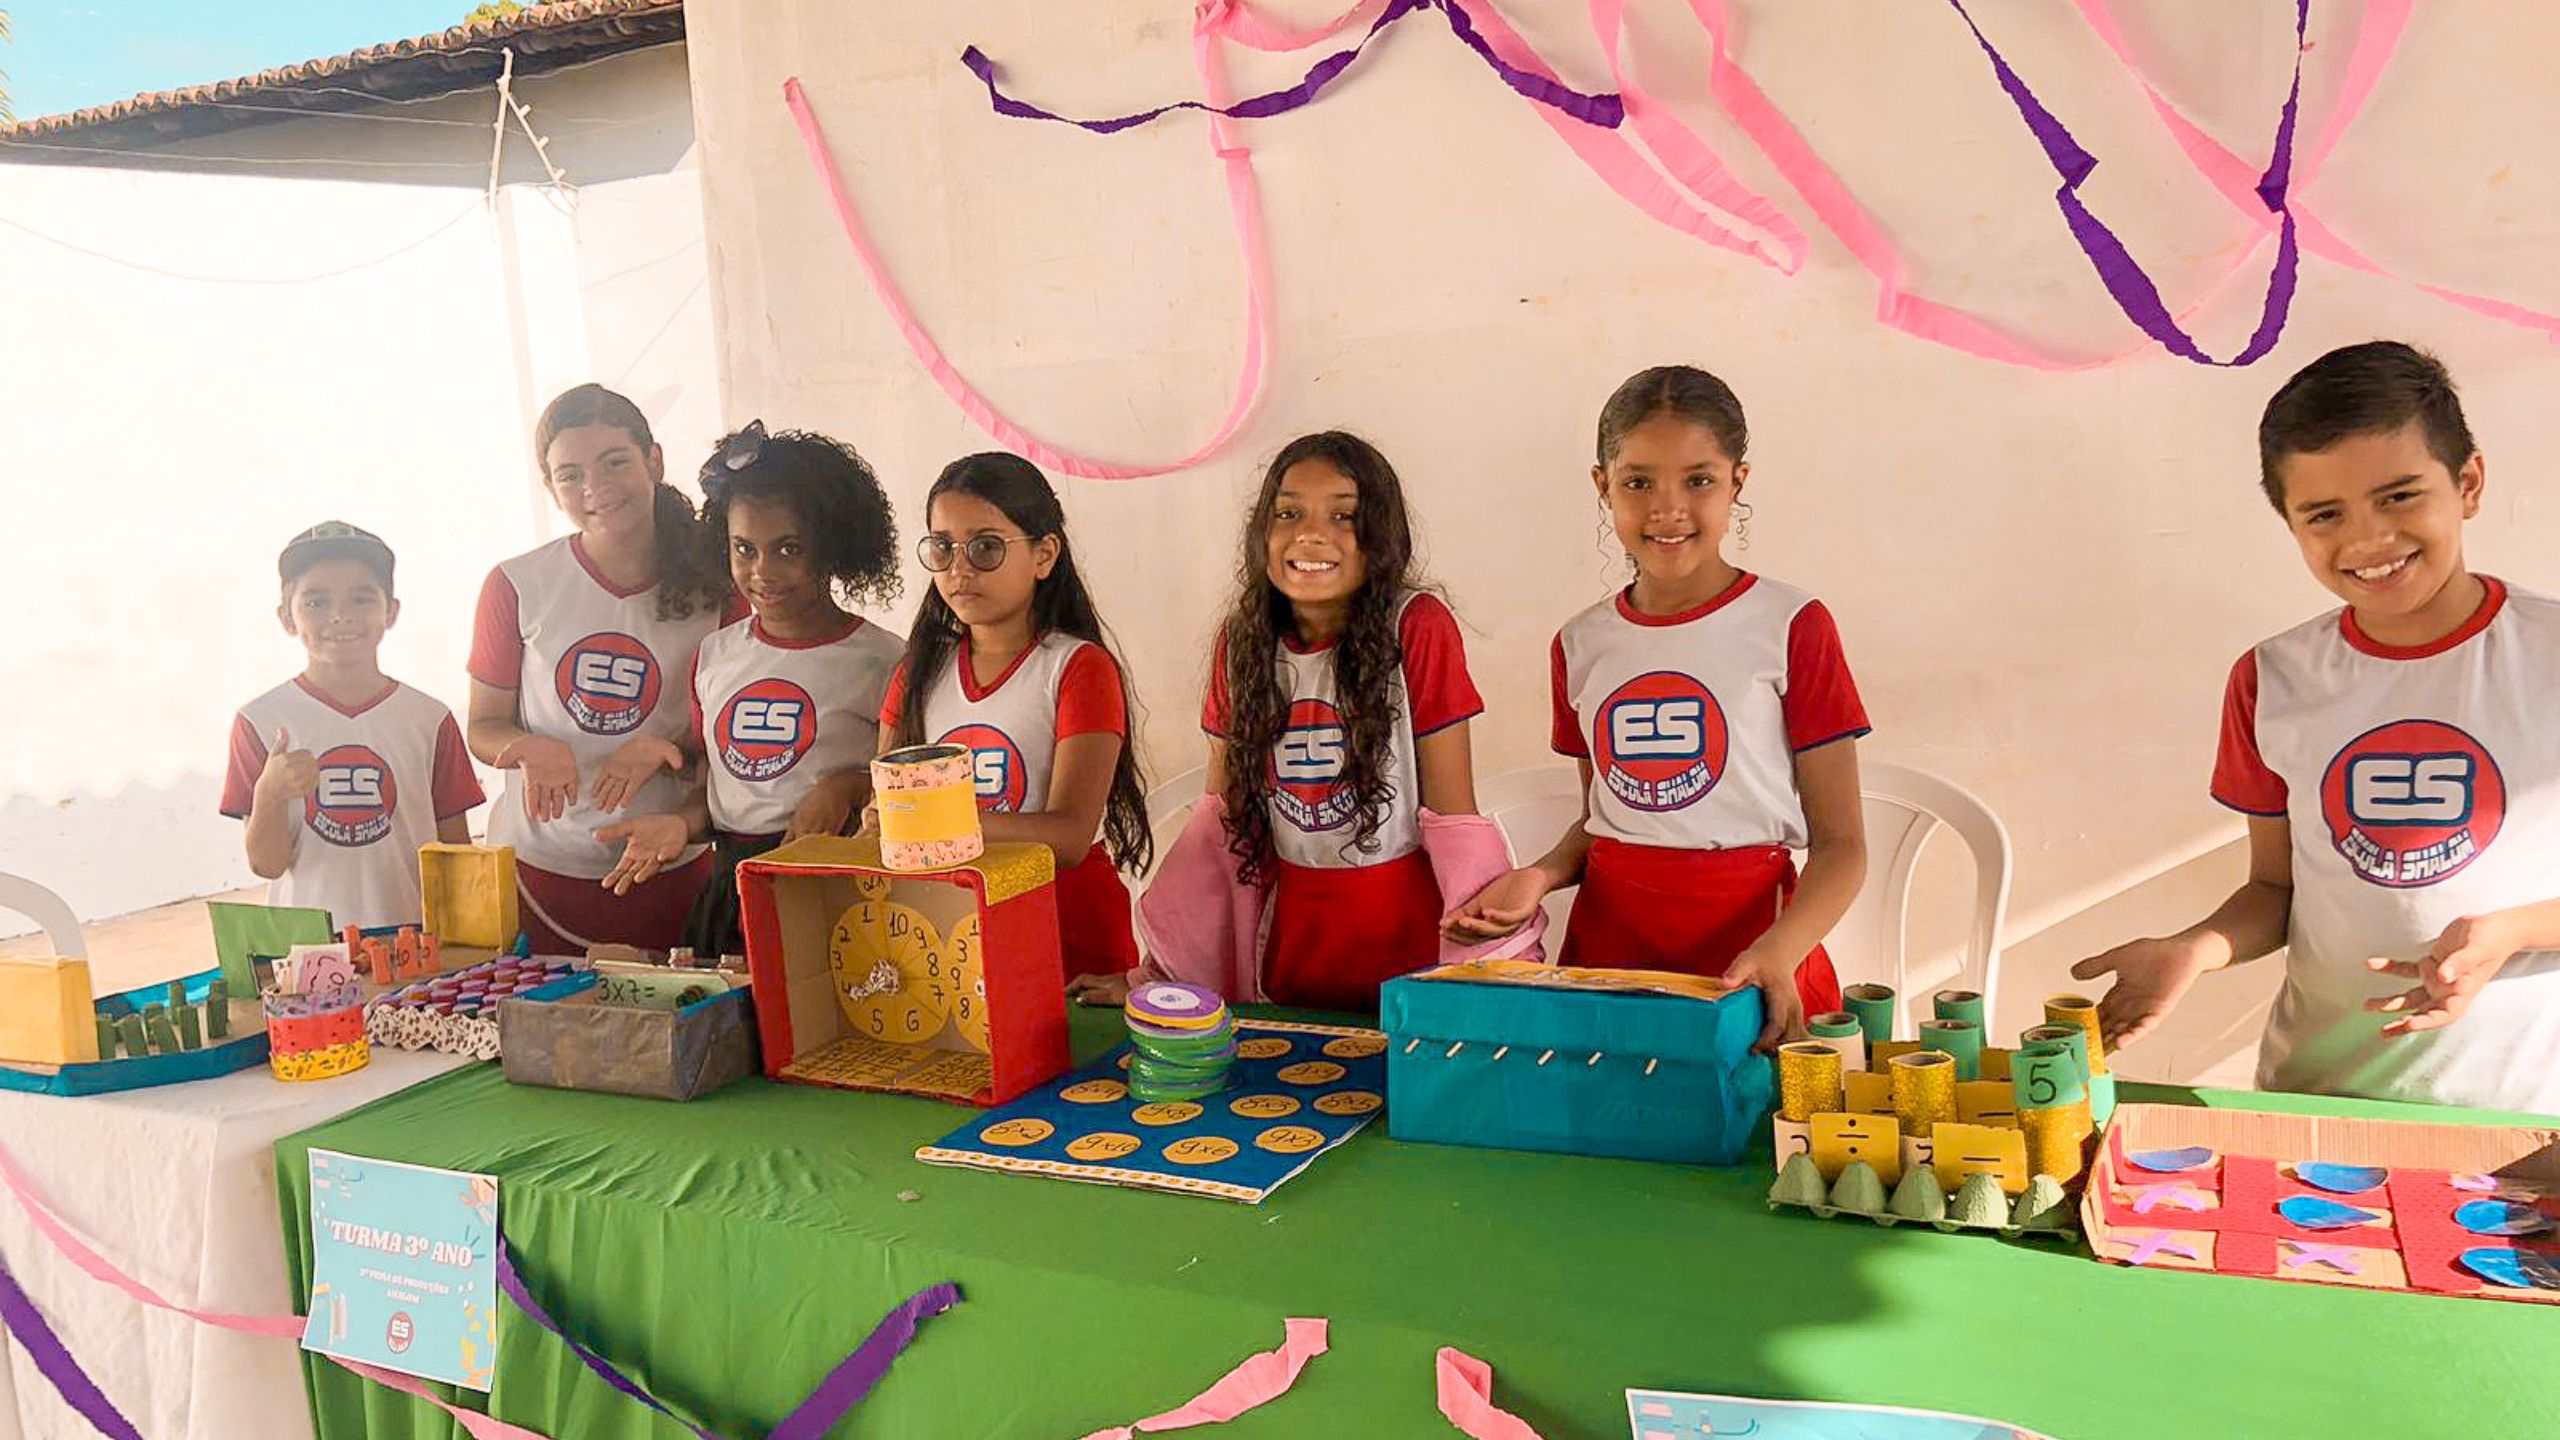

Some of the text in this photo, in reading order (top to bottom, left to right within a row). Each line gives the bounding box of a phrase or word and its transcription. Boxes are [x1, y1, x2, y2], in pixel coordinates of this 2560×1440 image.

[576, 652, 646, 697] ES
[732, 701, 799, 741] ES
[1612, 701, 1701, 755] ES
[1274, 728, 1345, 778] ES
[319, 768, 383, 805] ES
[2352, 758, 2468, 820] ES
[889, 911, 909, 938] 10
[926, 951, 940, 978] 8
[959, 996, 971, 1020] 8
[2028, 1062, 2057, 1104] 5
[330, 1219, 402, 1255] TURMA
[430, 1240, 474, 1269] ANO
[391, 1319, 410, 1339] ES
